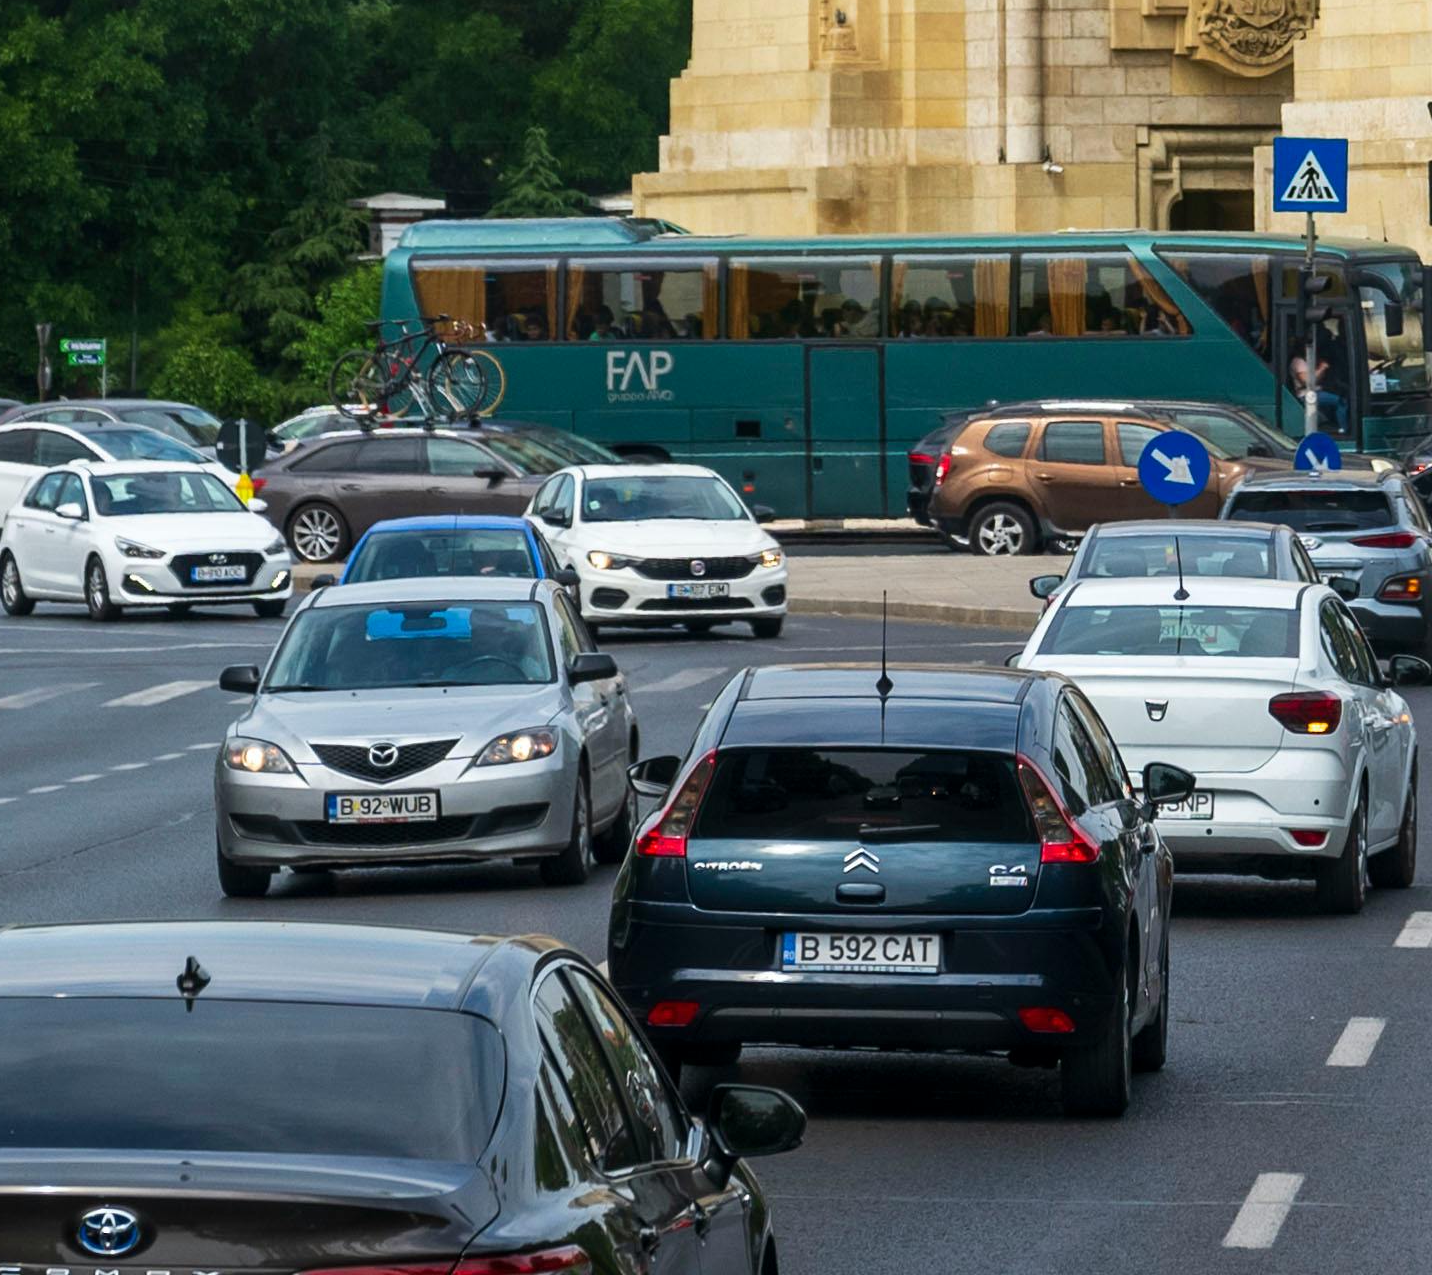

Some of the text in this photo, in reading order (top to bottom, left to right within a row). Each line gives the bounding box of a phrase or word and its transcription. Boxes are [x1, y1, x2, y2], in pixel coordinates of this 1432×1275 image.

[607, 351, 673, 390] FAP
[340, 796, 431, 815] B 92 WUB
[800, 936, 933, 961] B 592 CAT
